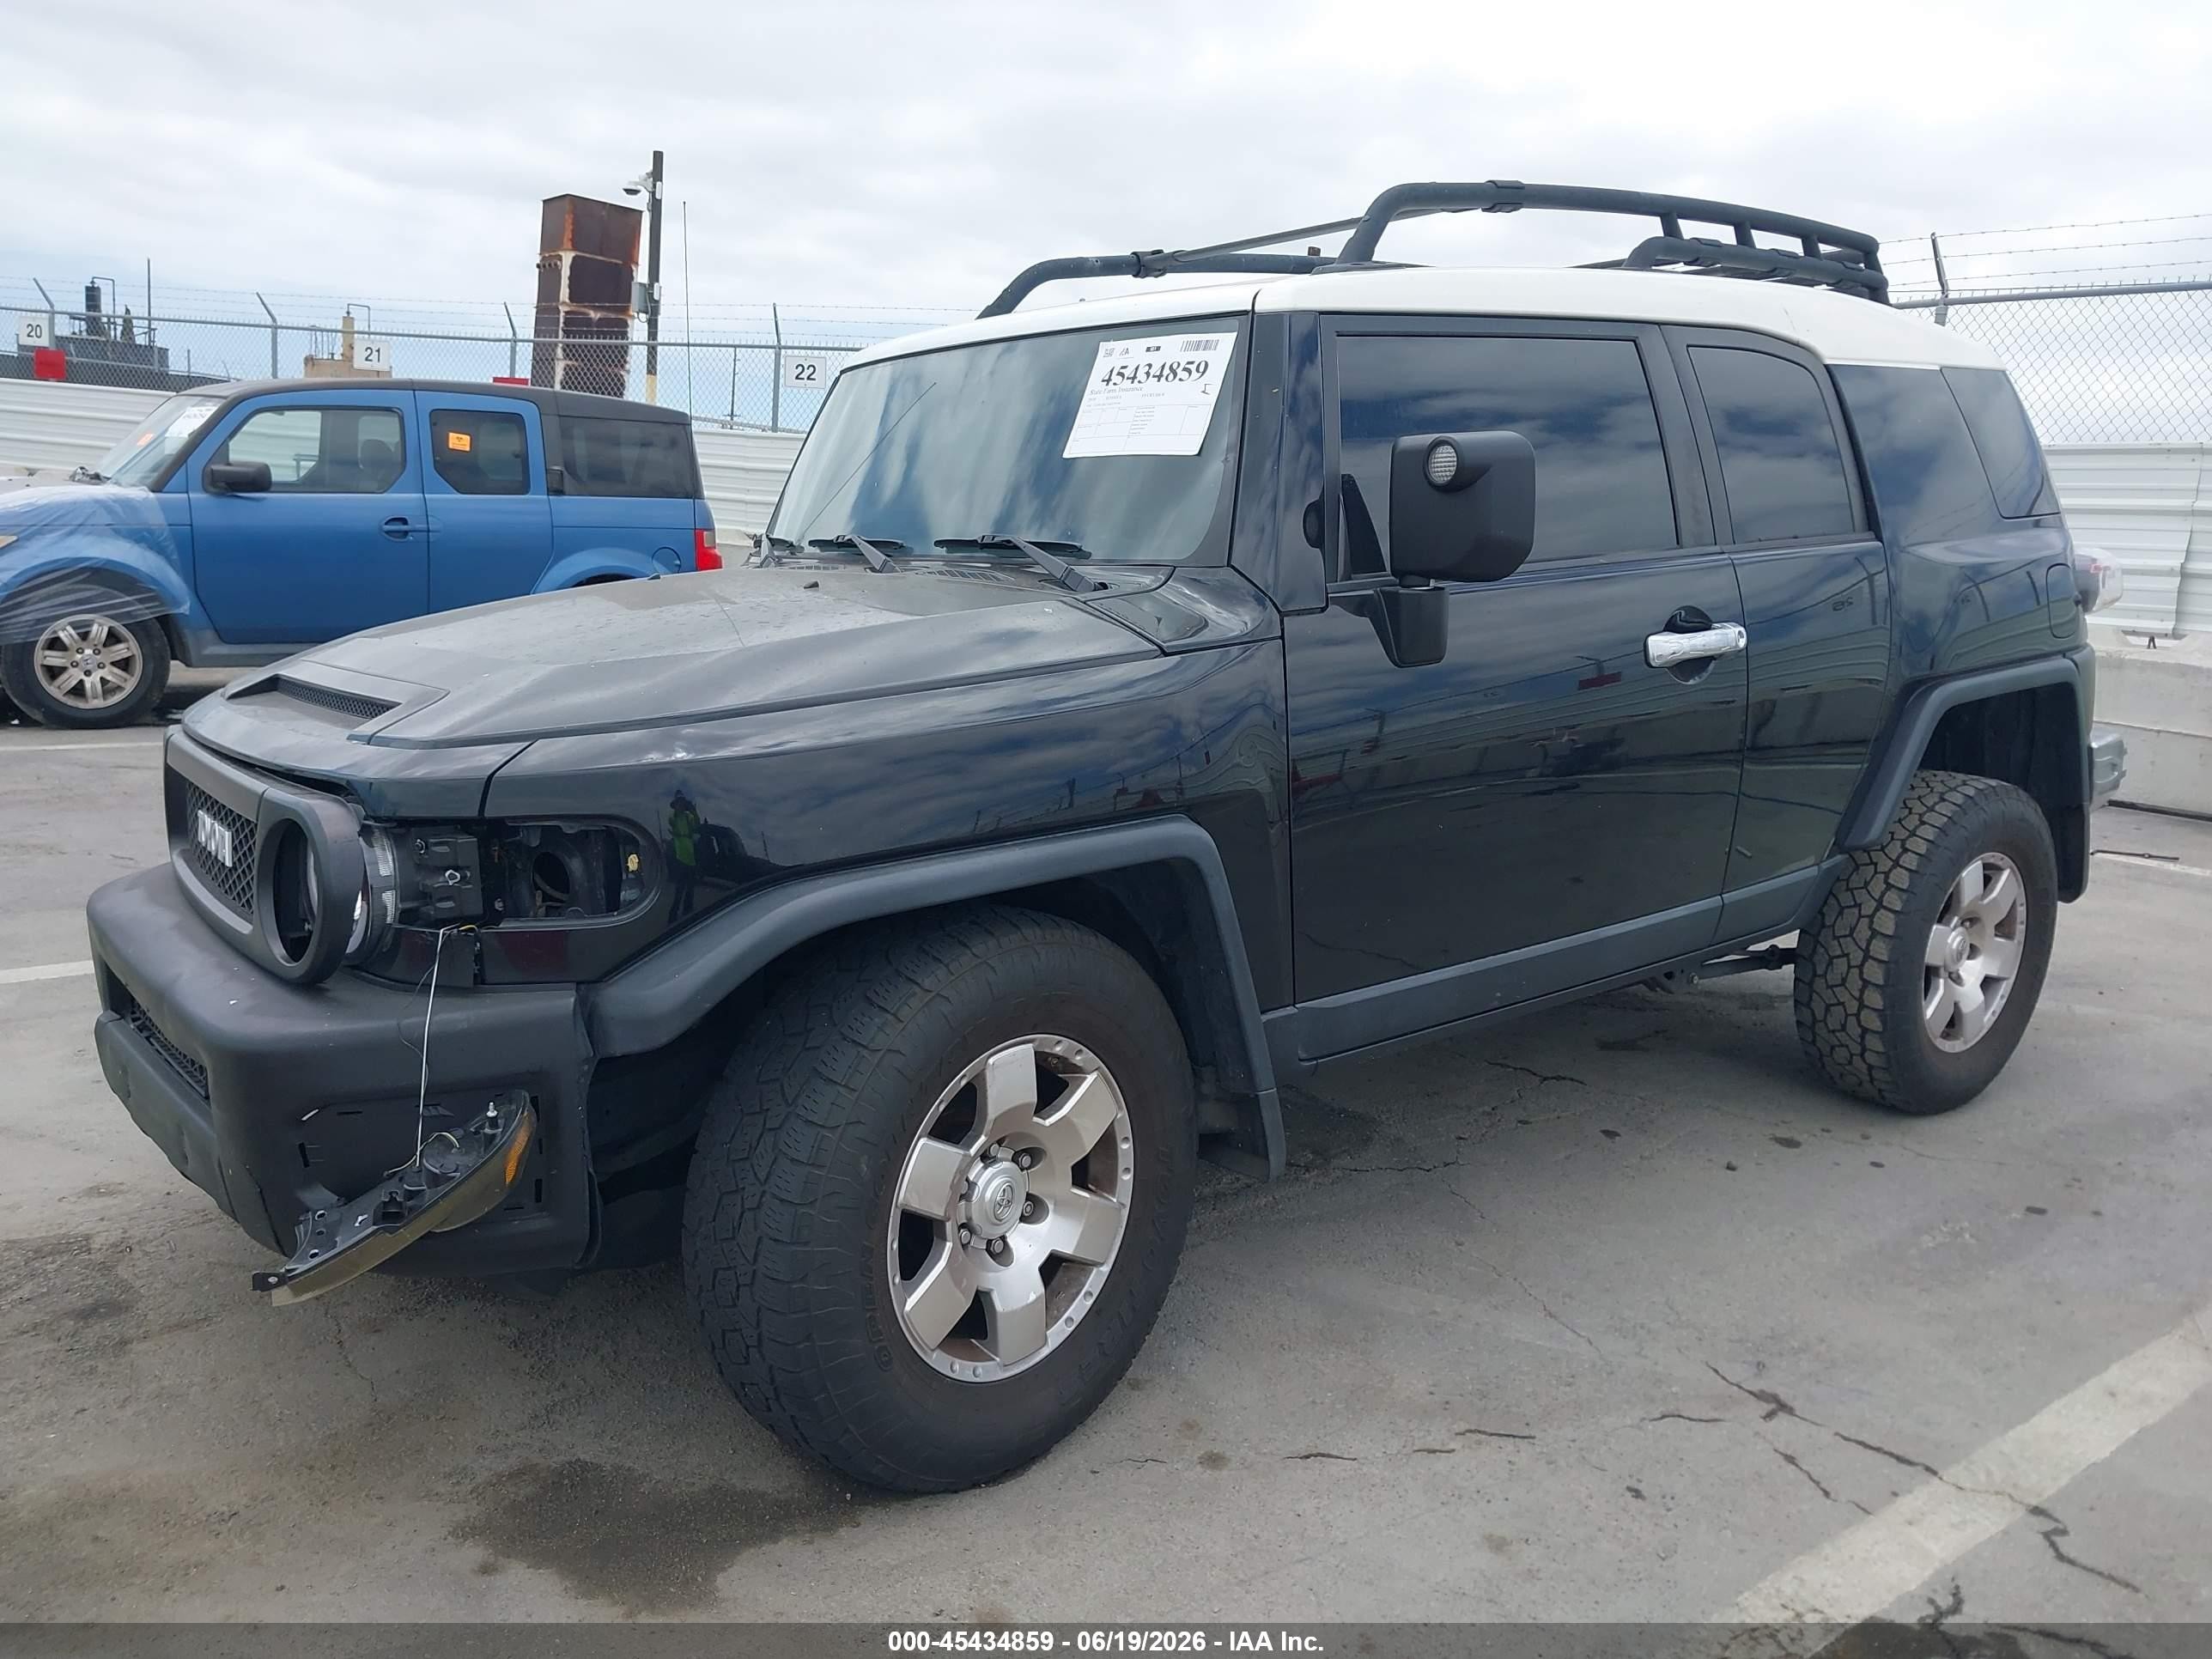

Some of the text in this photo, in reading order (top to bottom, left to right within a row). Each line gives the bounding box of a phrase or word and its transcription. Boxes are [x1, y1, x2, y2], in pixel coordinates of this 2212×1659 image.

[27, 323, 42, 339] 20
[364, 346, 381, 363] 21
[794, 363, 817, 381] 22
[1101, 360, 1209, 386] 45434859
